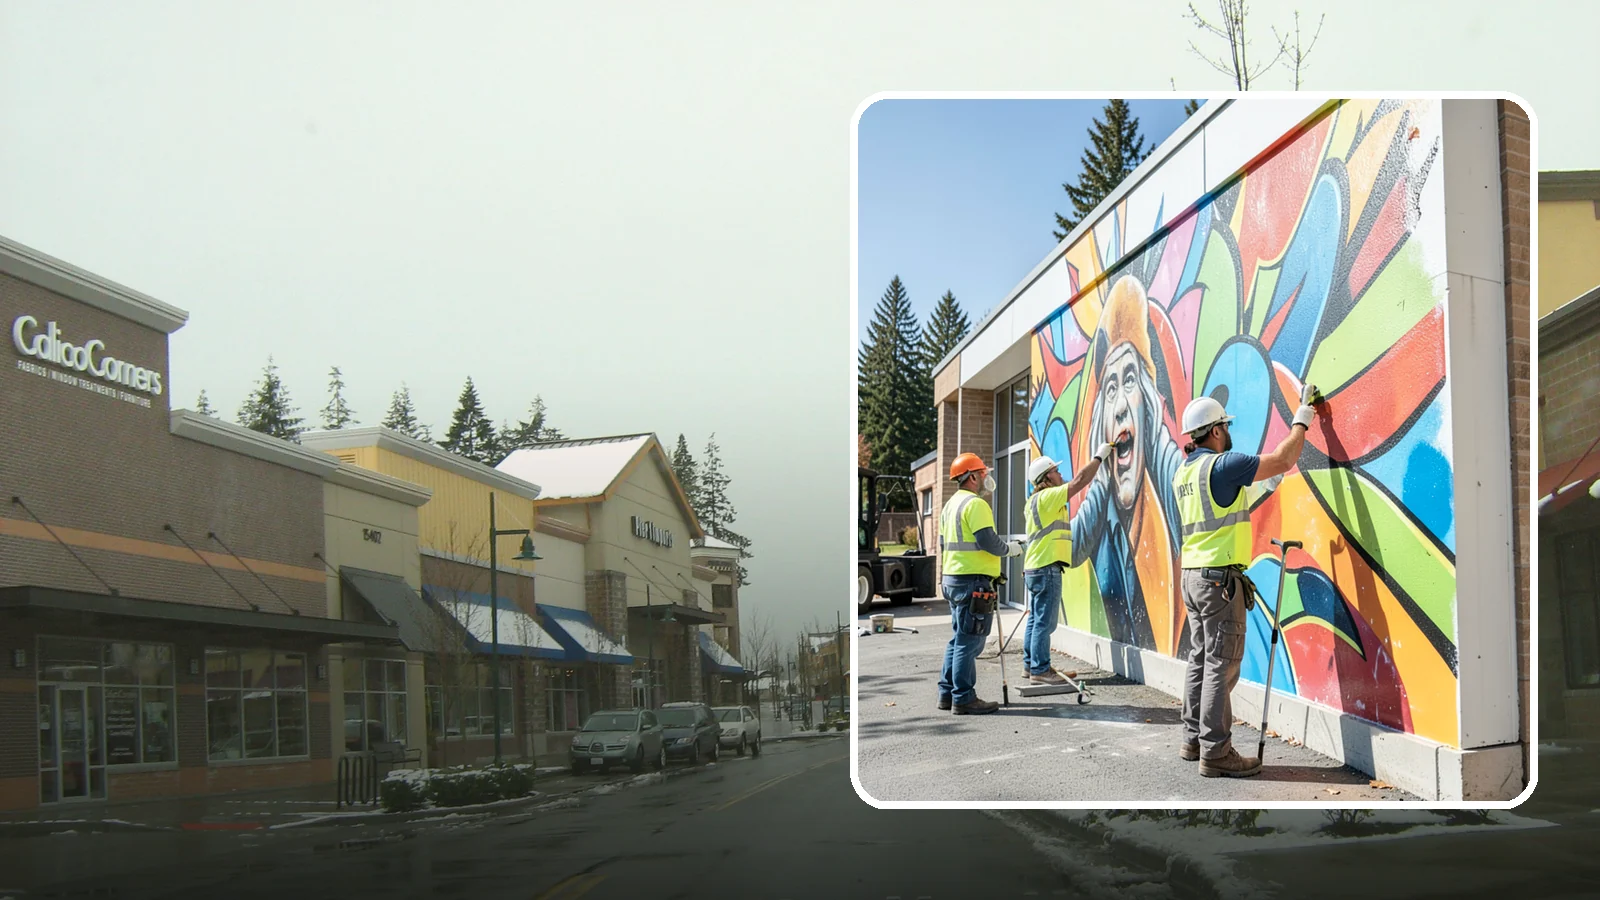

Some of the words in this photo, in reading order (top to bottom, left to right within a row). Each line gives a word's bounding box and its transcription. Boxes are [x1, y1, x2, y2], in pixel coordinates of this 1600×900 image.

[17, 360, 47, 377] FABRICS
[51, 370, 78, 386] WINDOW
[79, 378, 117, 398] TREATMENTS
